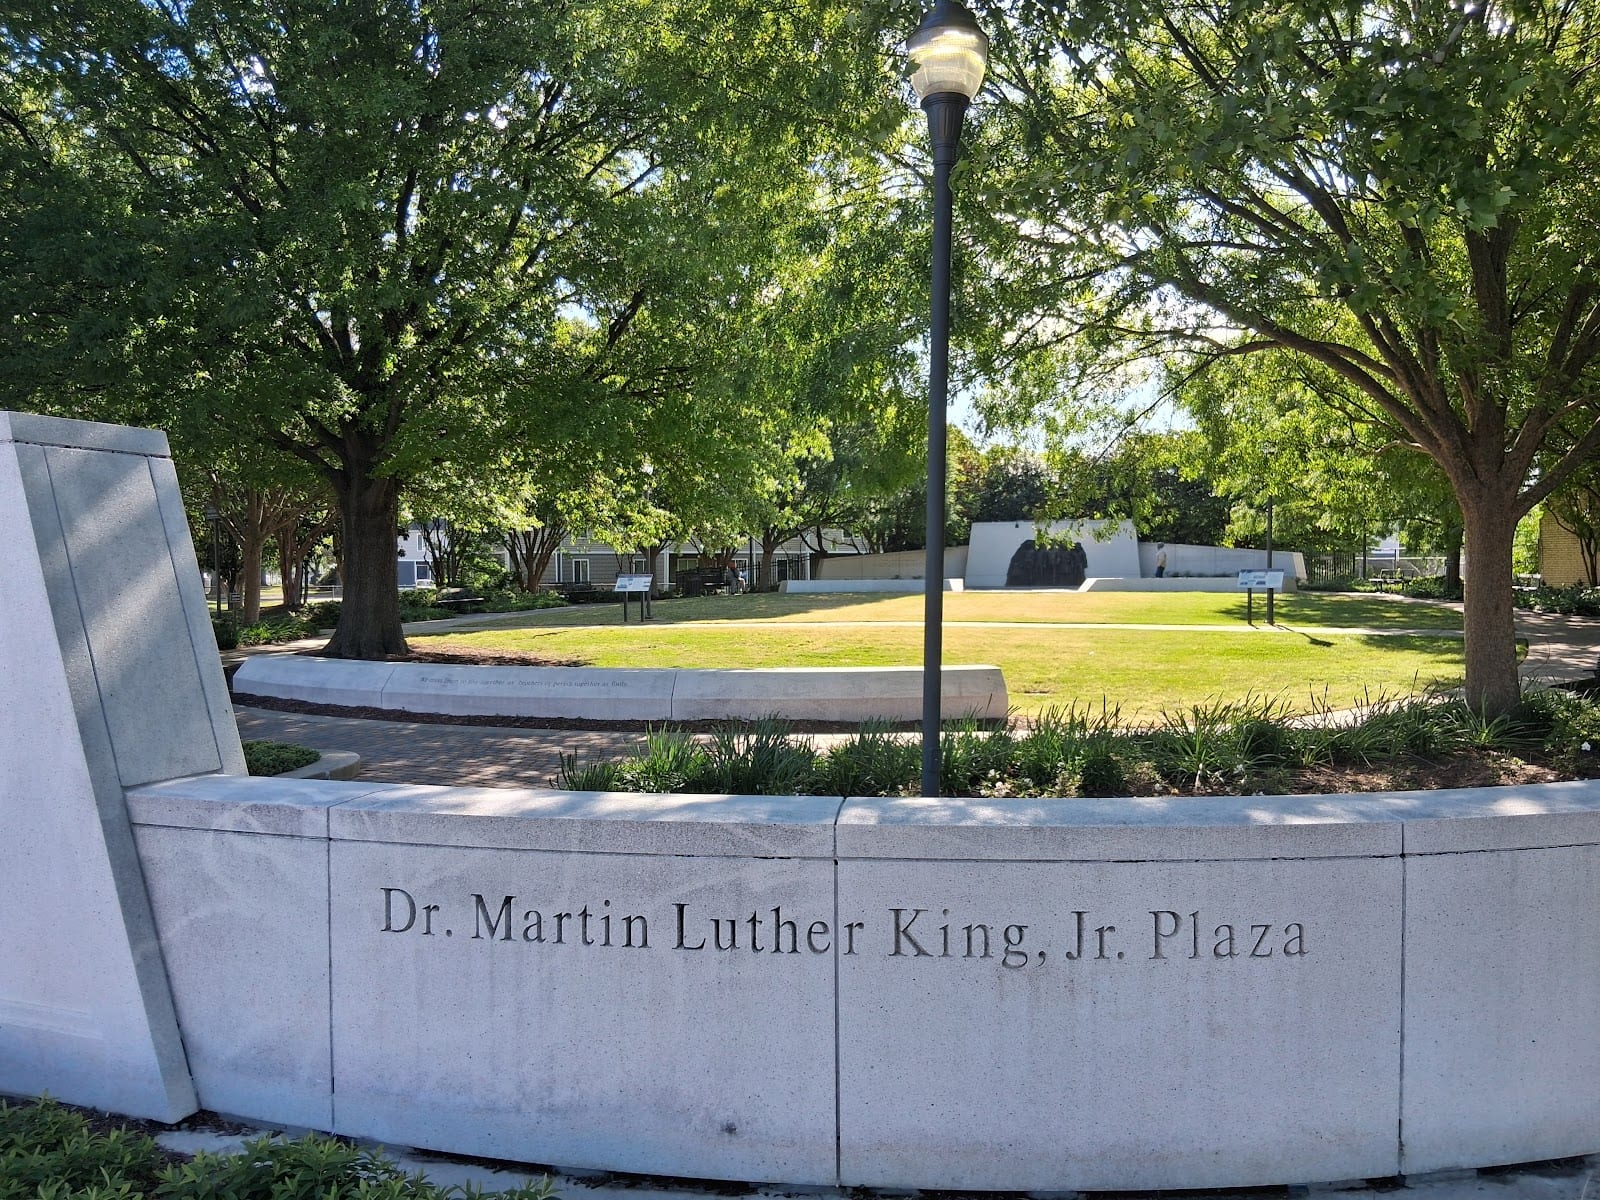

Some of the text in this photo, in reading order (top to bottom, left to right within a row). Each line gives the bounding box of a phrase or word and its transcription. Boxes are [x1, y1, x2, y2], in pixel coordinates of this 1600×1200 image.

[379, 886, 1310, 970] Dr. Martin Luther King, Jr. Plaza
